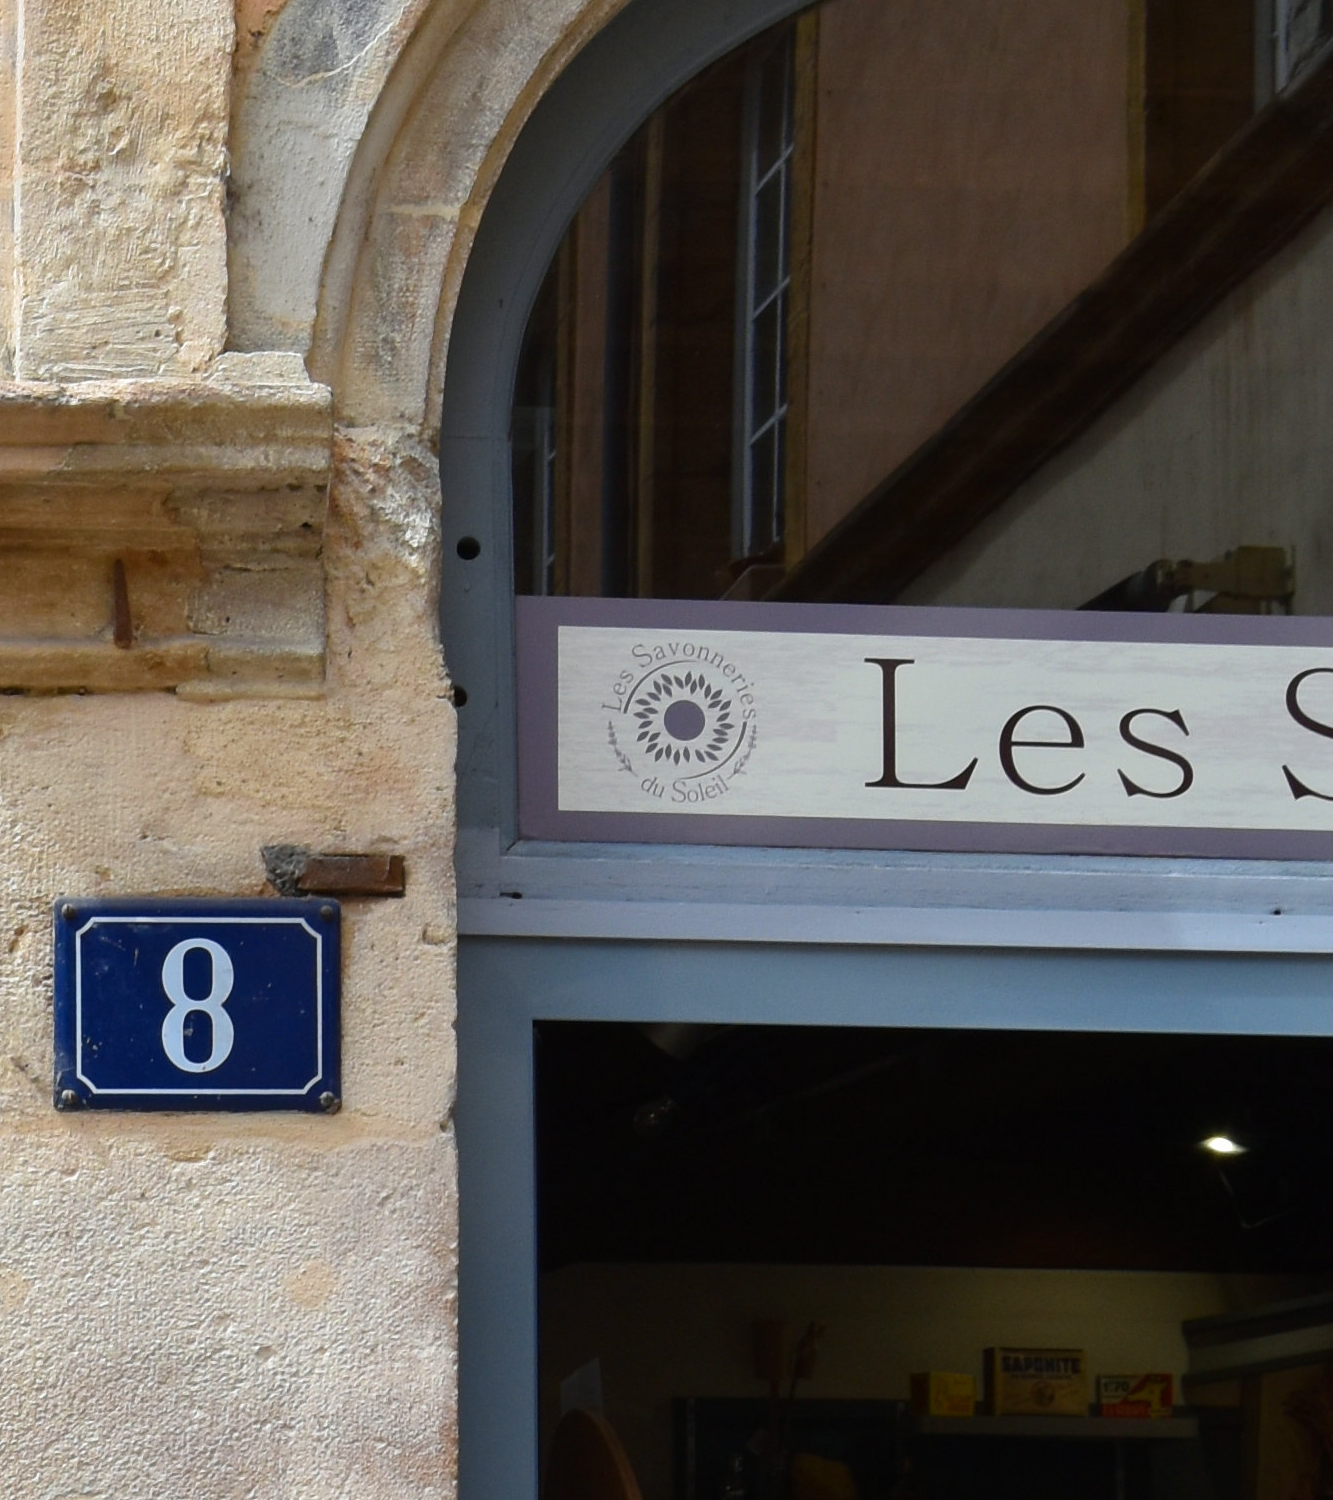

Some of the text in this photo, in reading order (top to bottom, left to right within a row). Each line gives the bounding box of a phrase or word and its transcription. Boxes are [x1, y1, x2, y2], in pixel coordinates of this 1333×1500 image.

[602, 641, 757, 720] Les Savonneries
[864, 656, 1195, 799] Les
[640, 774, 729, 803] du Soleil
[161, 937, 234, 1073] 8
